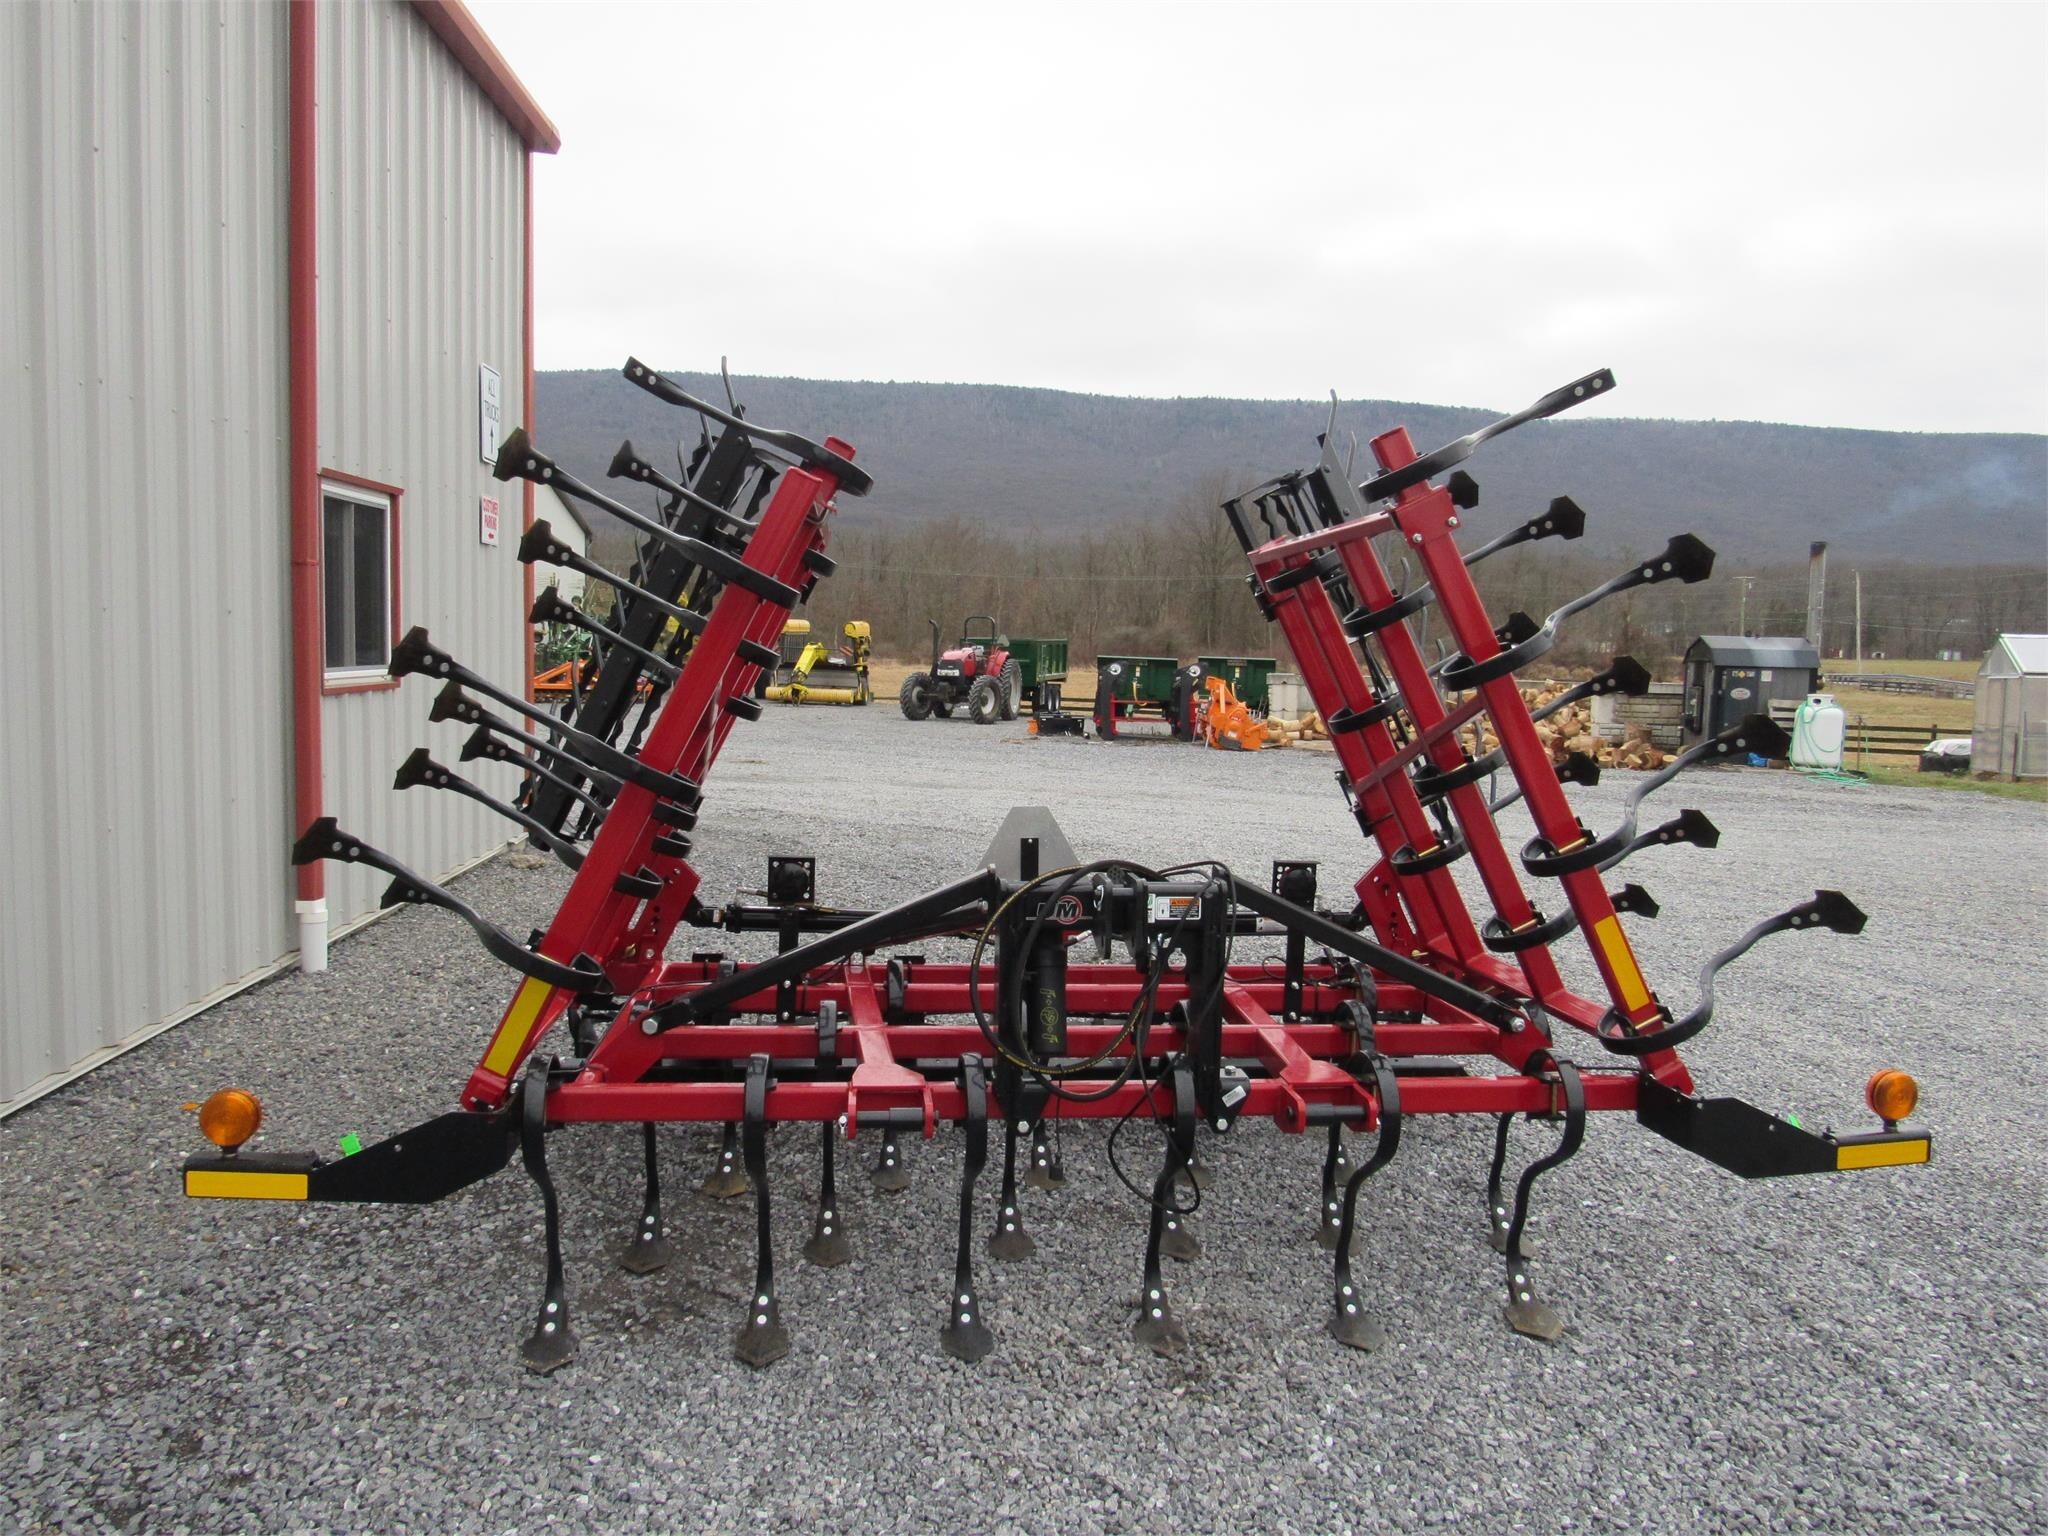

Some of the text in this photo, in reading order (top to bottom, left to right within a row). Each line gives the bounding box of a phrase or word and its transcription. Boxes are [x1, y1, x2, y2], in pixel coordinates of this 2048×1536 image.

[484, 400, 500, 424] TRUCKS
[483, 497, 498, 516] CUSTOMER
[485, 514, 497, 531] PARKING
